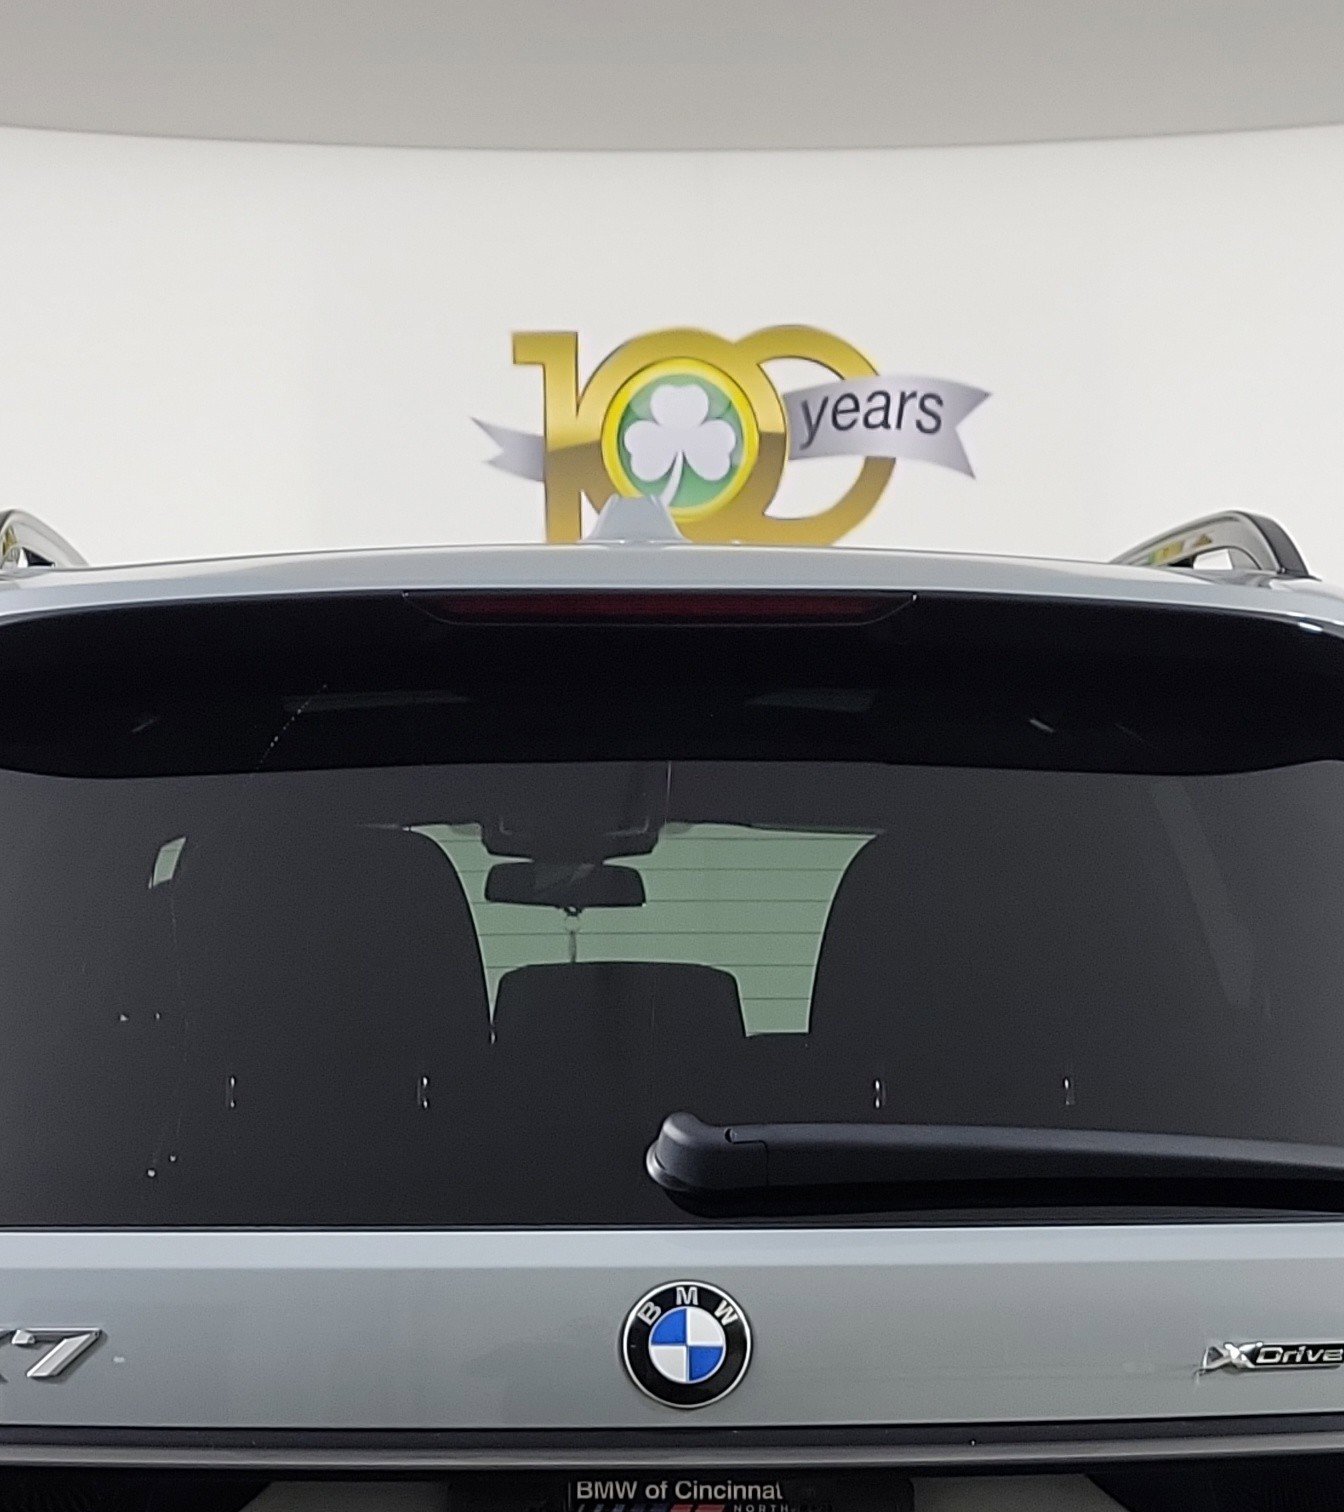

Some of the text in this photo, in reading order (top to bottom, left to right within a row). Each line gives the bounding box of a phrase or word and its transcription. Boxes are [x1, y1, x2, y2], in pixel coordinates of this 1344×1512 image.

[511, 324, 945, 545] 100 years
[637, 1286, 739, 1326] BMW
[576, 1480, 784, 1500] BMW of Cincinnat
